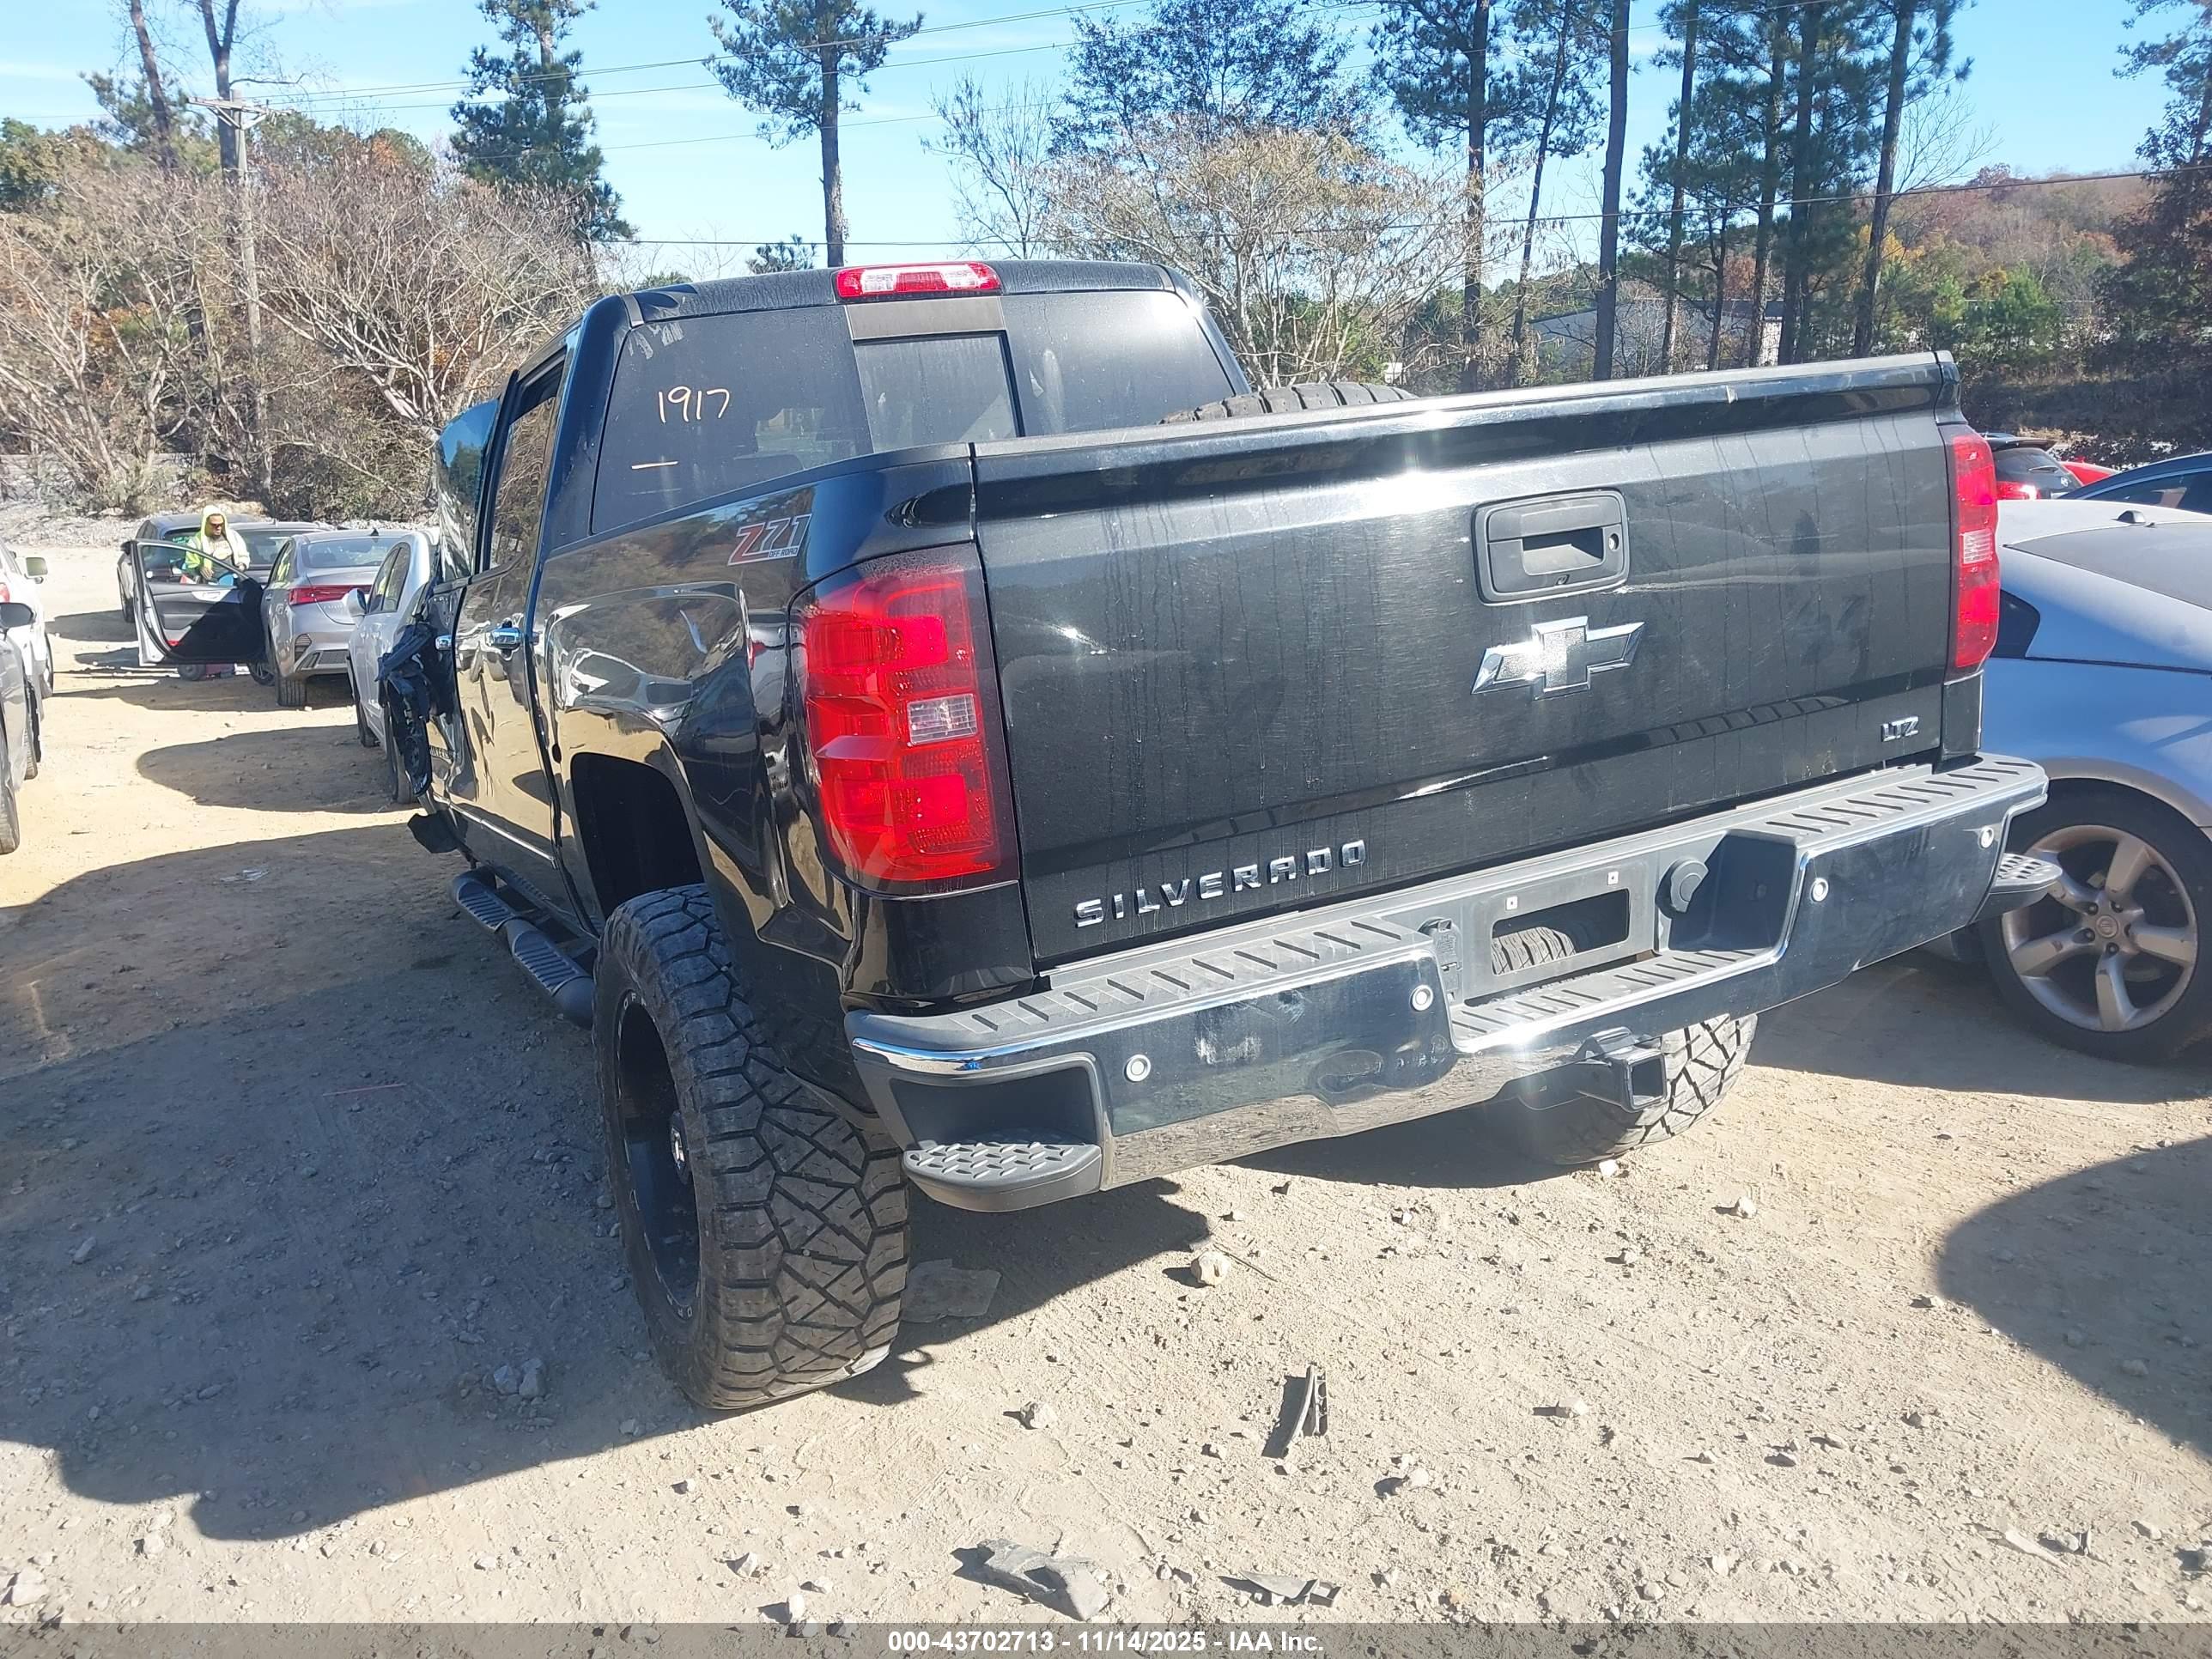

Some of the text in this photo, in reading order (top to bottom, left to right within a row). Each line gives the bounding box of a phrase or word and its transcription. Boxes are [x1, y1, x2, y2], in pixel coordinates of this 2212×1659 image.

[658, 386, 730, 423] 1917
[727, 514, 812, 566] Z71
[781, 547, 799, 556] ROAD
[1881, 715, 1919, 742] LTZ
[1074, 839, 1366, 928] SILVERADO
